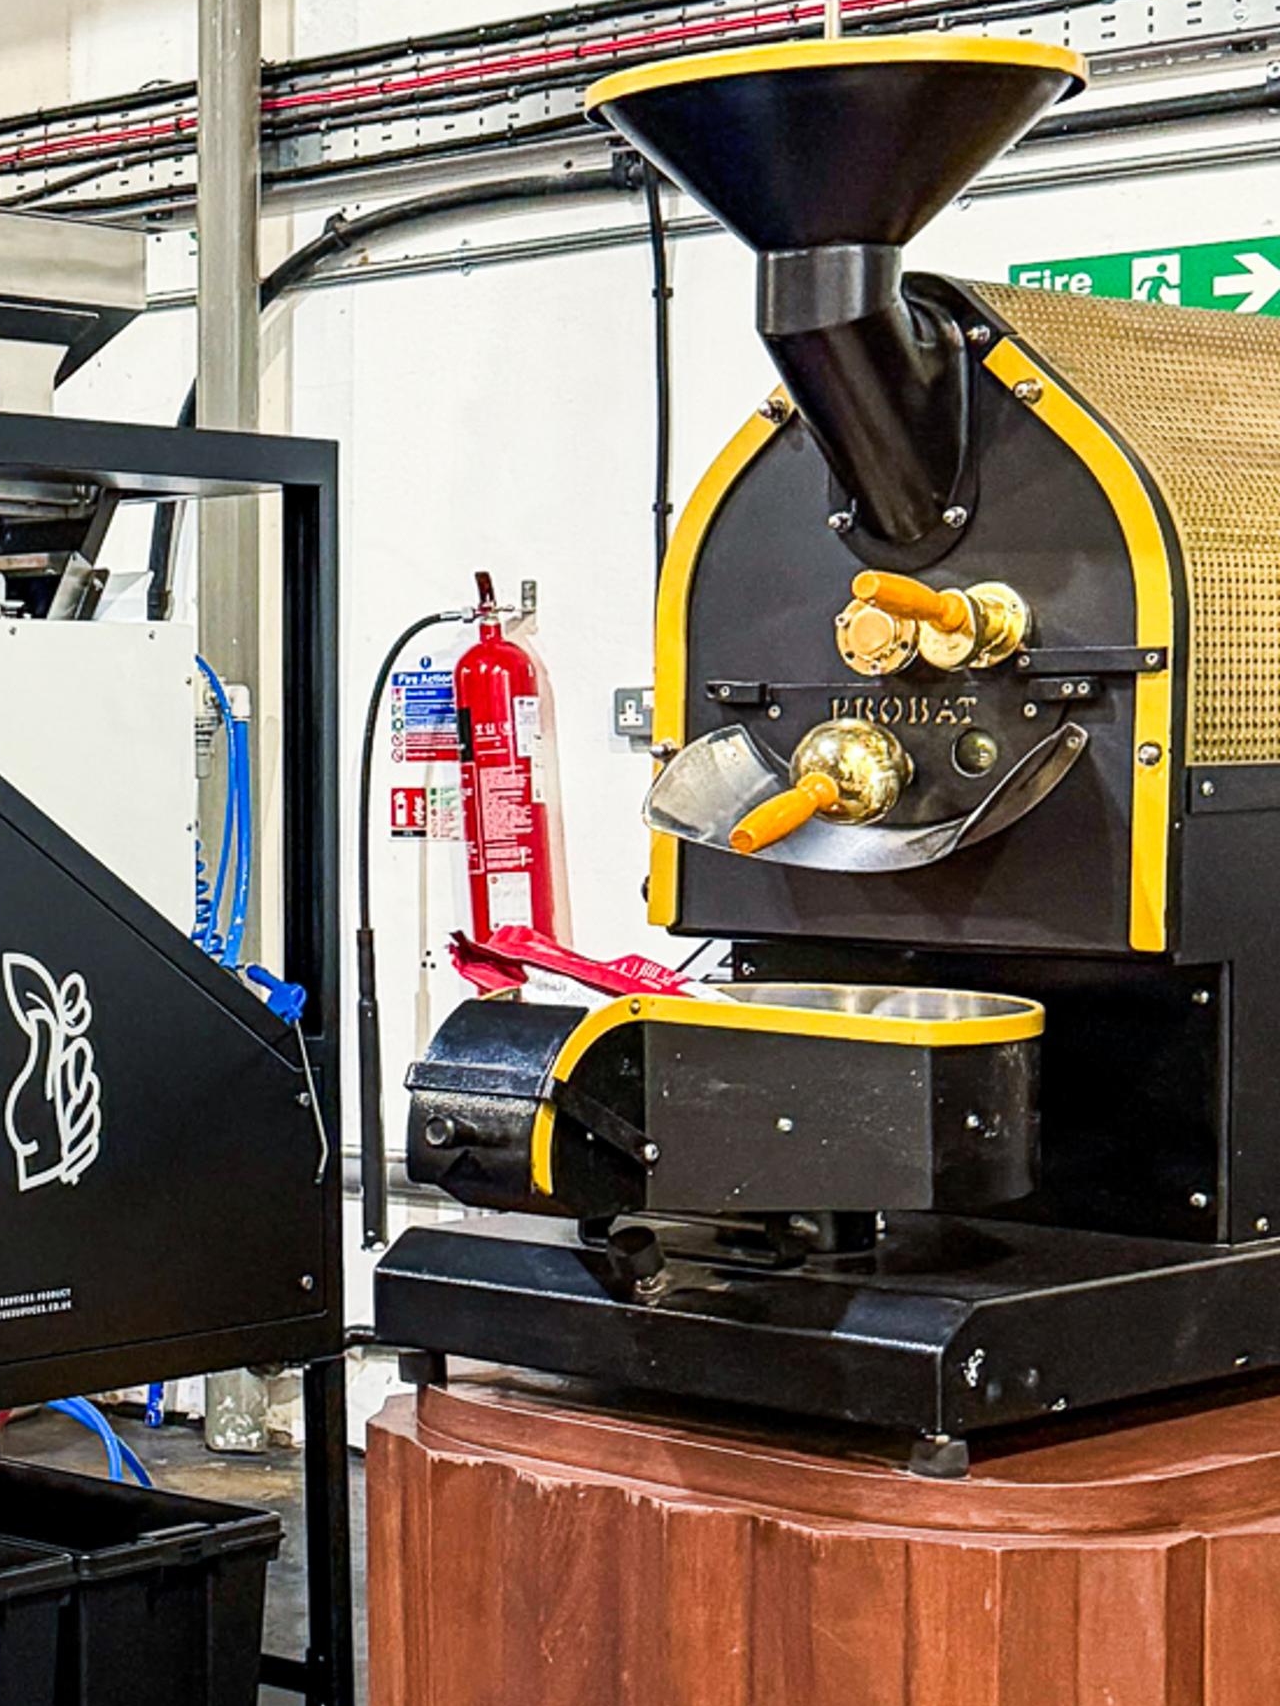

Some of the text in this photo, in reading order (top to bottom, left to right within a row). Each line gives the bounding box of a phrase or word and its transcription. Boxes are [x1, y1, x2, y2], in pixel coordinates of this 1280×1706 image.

[1019, 269, 1092, 294] Fire
[398, 674, 418, 685] Fire
[831, 696, 978, 725] PROBAT
